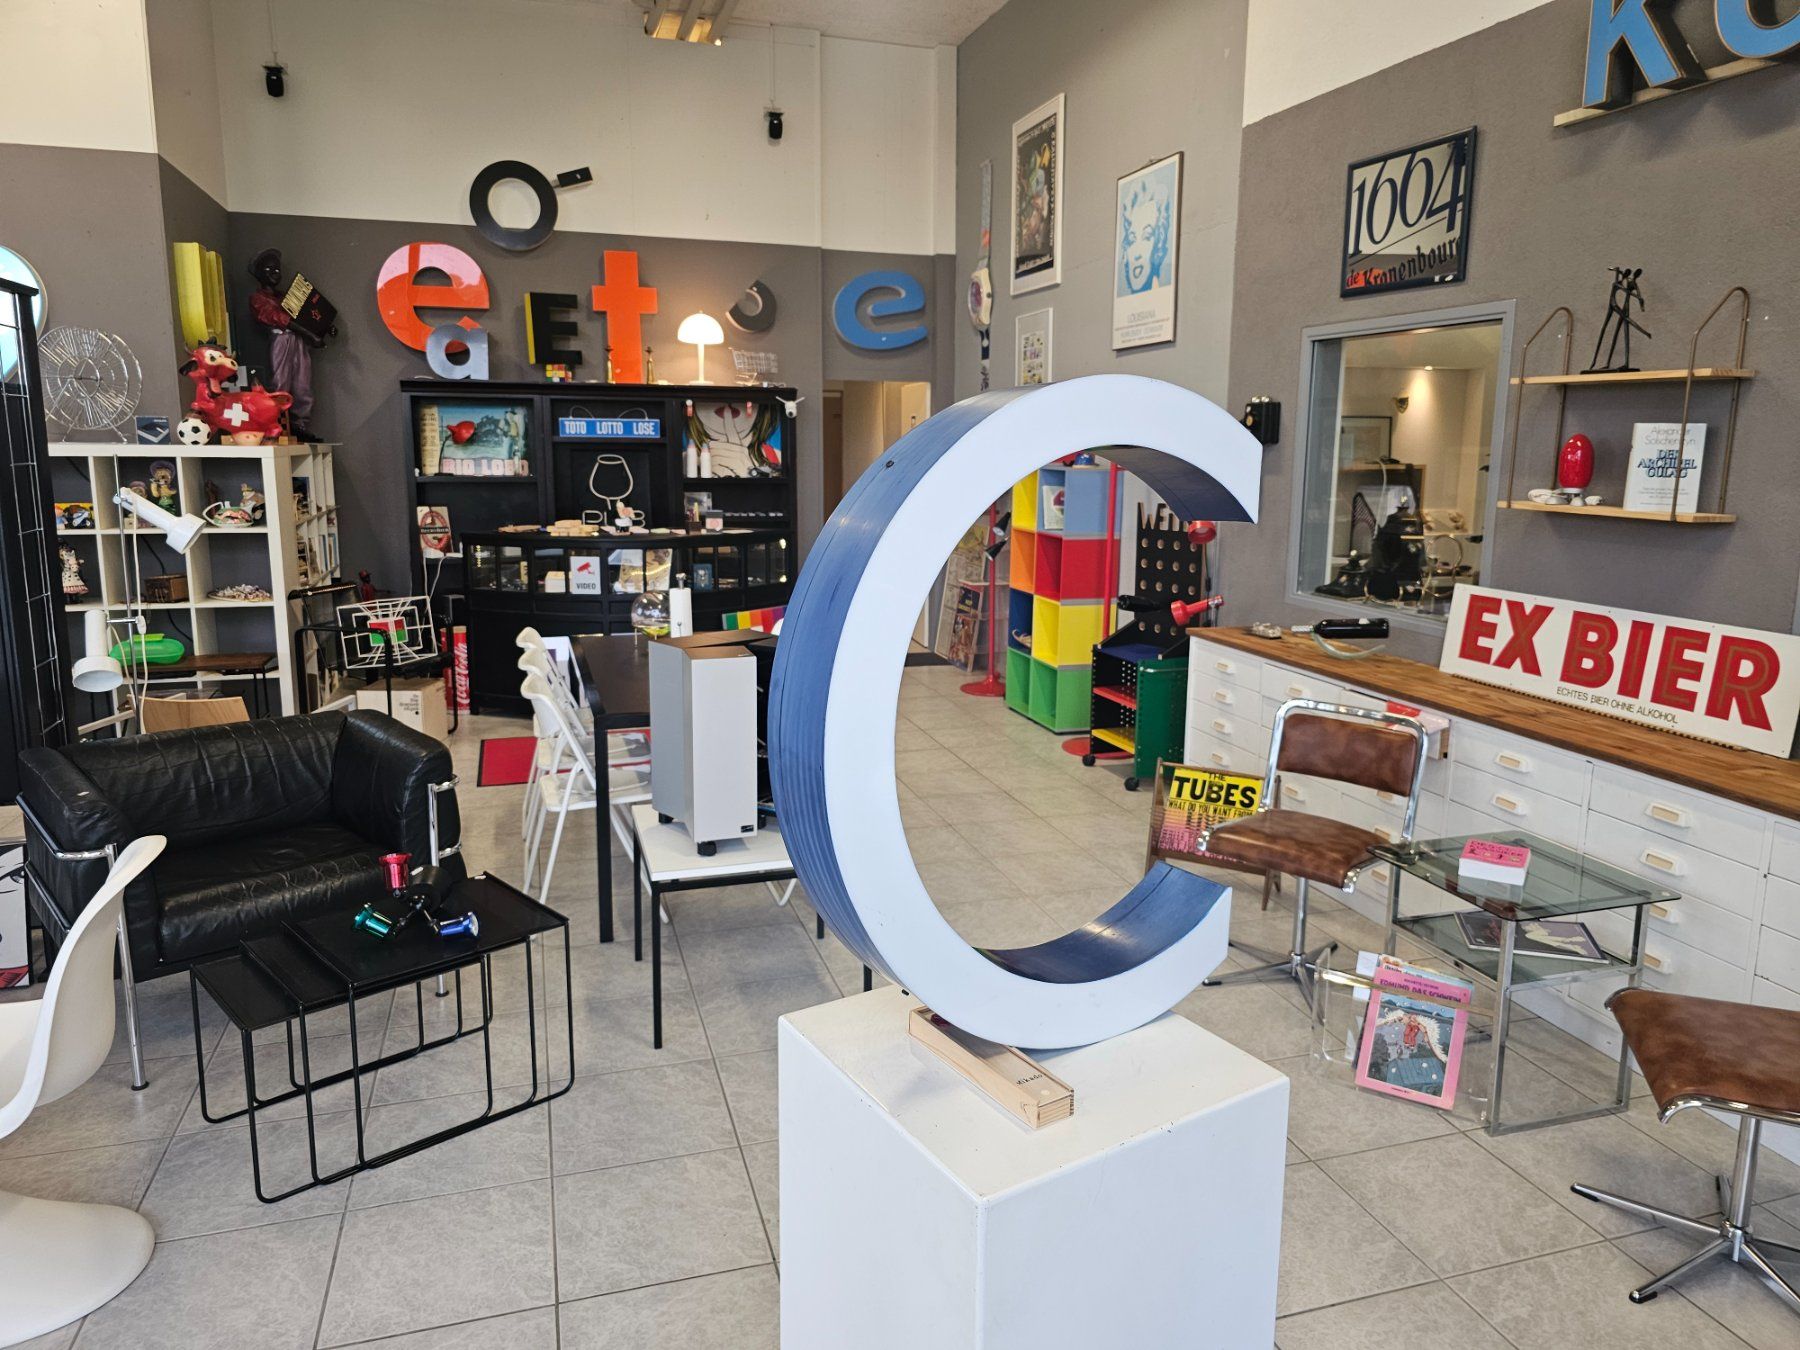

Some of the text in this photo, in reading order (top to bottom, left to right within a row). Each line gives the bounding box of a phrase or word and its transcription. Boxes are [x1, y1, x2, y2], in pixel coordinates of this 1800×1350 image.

[833, 270, 929, 350] e
[525, 292, 583, 365] E
[426, 323, 489, 380] a
[564, 421, 656, 435] TOTO LOTTO LOSE
[1637, 458, 1697, 470] ARCHIEL
[576, 582, 597, 590] VIDEO
[1458, 594, 1780, 731] EX BIER
[1556, 686, 1678, 724] ECHTES BIER OHNE ALKOHOL
[1169, 800, 1186, 810] WHAT
[1187, 802, 1197, 811] DO
[1199, 803, 1210, 813] YOU
[1213, 805, 1231, 817] WANT
[1174, 775, 1257, 809] TUBES
